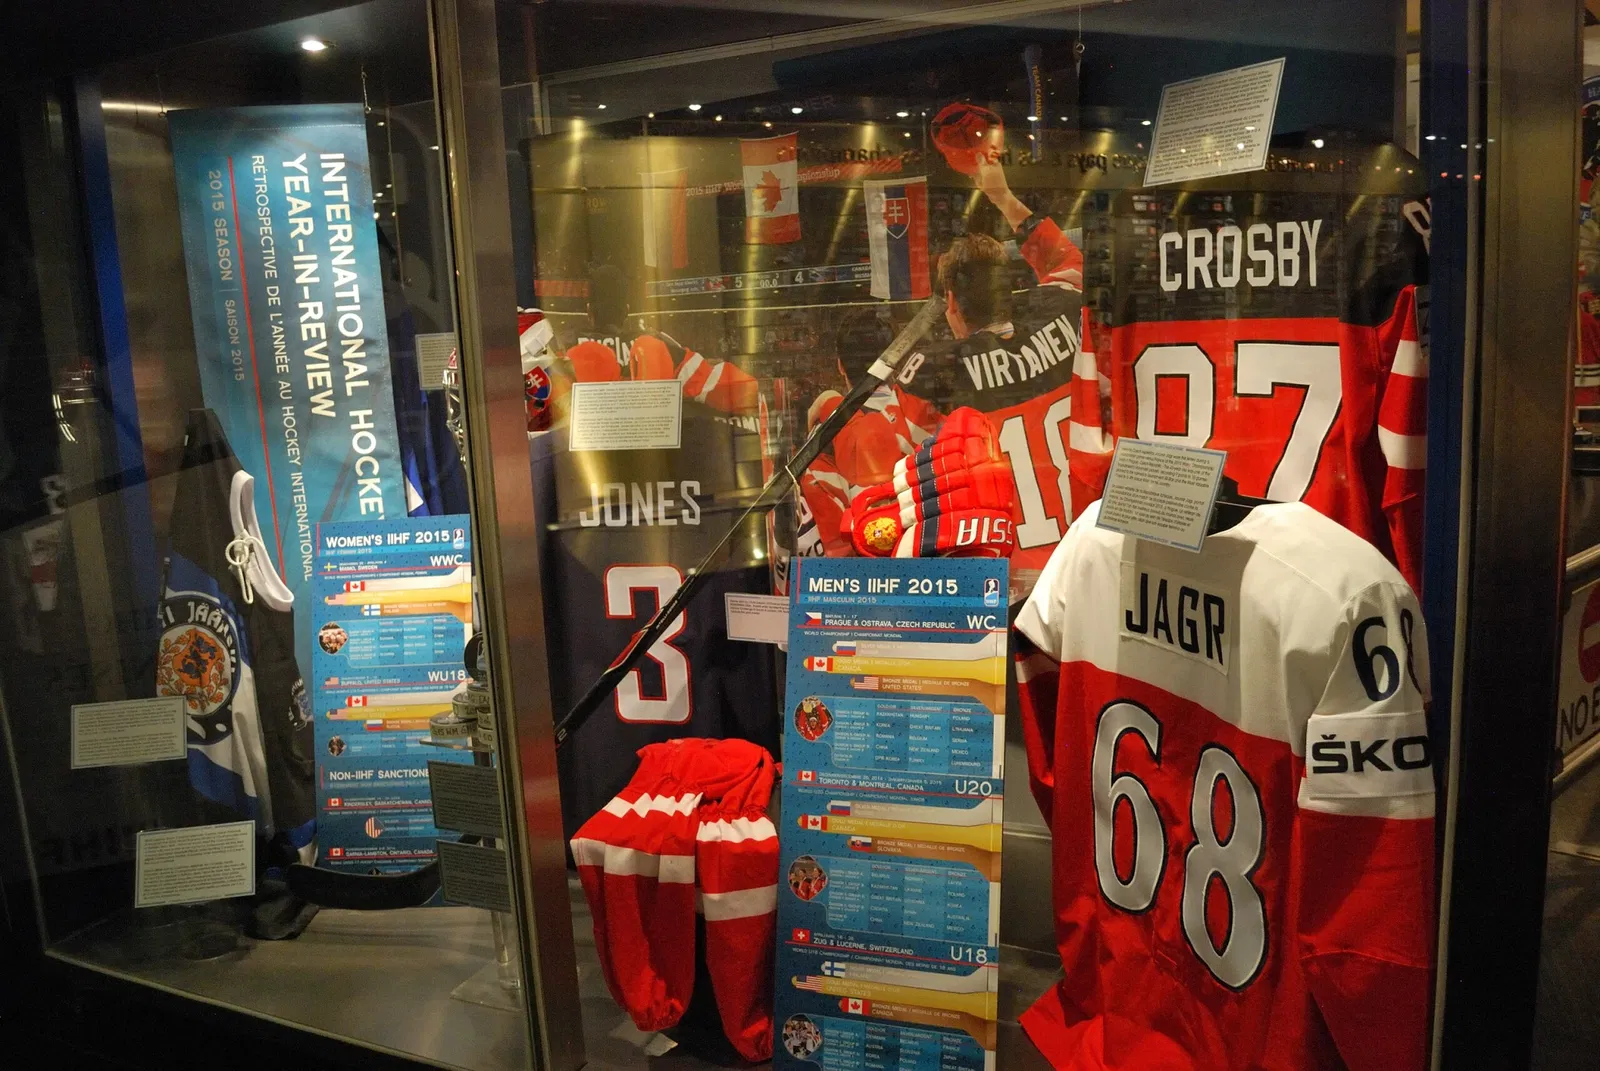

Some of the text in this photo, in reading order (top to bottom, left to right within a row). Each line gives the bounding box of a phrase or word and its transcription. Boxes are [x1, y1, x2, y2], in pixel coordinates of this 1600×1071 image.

[208, 169, 233, 282] 2015 SEASON
[251, 155, 278, 280] RÉTROSPECTIVE
[1159, 219, 1323, 292] CROSBY
[282, 153, 337, 418] YEAR-IN-REVIEW
[735, 277, 743, 288] 5
[794, 271, 804, 284] 4
[267, 286, 280, 306] DE
[225, 299, 245, 382] SAISON 2015
[320, 152, 364, 396] INTERNATIONAL
[349, 408, 386, 521] HOCKE
[963, 314, 1080, 391] VIRTANEN
[278, 380, 291, 400] AU
[282, 406, 302, 466] HOCKEY
[1133, 340, 1343, 503] 87
[579, 480, 702, 527] JONES
[290, 472, 314, 581] INTERNATIONAL
[326, 530, 450, 548] WOMEN'S IIHF 2015
[430, 555, 463, 567] WWC
[808, 577, 958, 595] MEN'S IIHF 2015
[853, 619, 859, 627] &
[861, 620, 894, 628] OSTRAVA,
[896, 620, 920, 628] CZECH
[922, 621, 956, 629] REPUBLIC
[966, 615, 997, 630] WC
[1125, 573, 1226, 666] JAGR
[604, 563, 693, 725] 3
[428, 670, 466, 682] WU18
[1560, 694, 1589, 751] NO
[1312, 735, 1432, 774] ŠKO
[329, 770, 374, 781] NON-IIHF
[819, 777, 850, 786] TORONTO
[859, 780, 894, 790] MONTREAL,
[897, 783, 924, 791] CANADA
[955, 779, 993, 796] U20
[1092, 698, 1267, 993] 68
[813, 937, 827, 946] ZUG
[837, 940, 867, 950] LUCERNE,
[869, 943, 914, 955] SWITZERLAND
[950, 945, 988, 964] U18
[871, 1009, 894, 1017] CANADA
